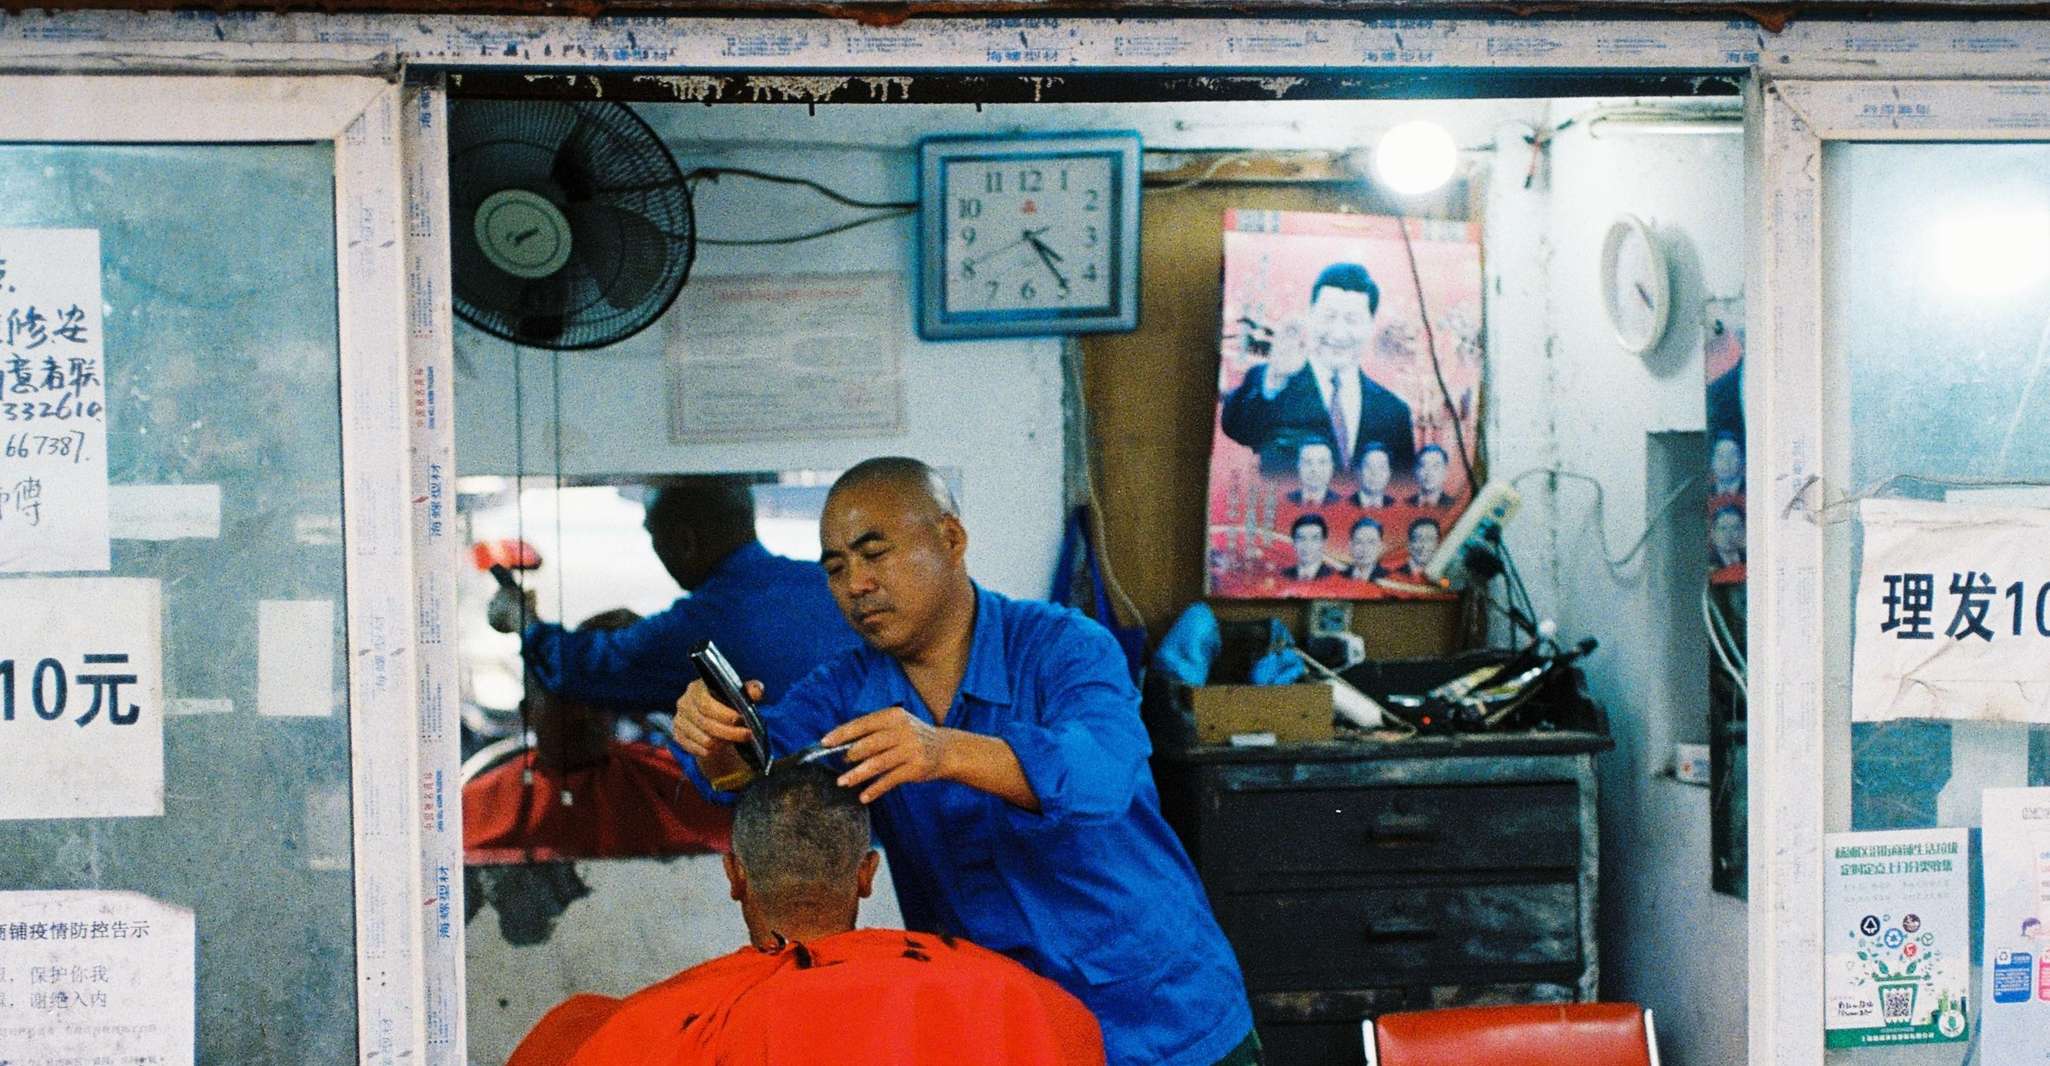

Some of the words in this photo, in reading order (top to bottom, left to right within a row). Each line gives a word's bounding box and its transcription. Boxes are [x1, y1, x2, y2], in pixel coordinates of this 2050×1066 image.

[985, 172, 1003, 193] 11
[1019, 169, 1042, 192] 12
[1060, 170, 1068, 191] 1
[959, 198, 982, 219] 10
[1084, 189, 1099, 211] 2
[962, 226, 977, 247] 9
[1085, 224, 1099, 247] 3
[961, 257, 977, 280] 8
[1083, 263, 1098, 282] 4
[987, 279, 998, 301] 7
[1020, 280, 1037, 301] 6
[0, 303, 88, 349] 修安
[0, 352, 100, 397] 意者联
[430, 464, 442, 536] 海螺型材
[0, 653, 140, 728] 10元
[438, 866, 450, 938] 海螺型材
[30, 965, 110, 984] 保护你我
